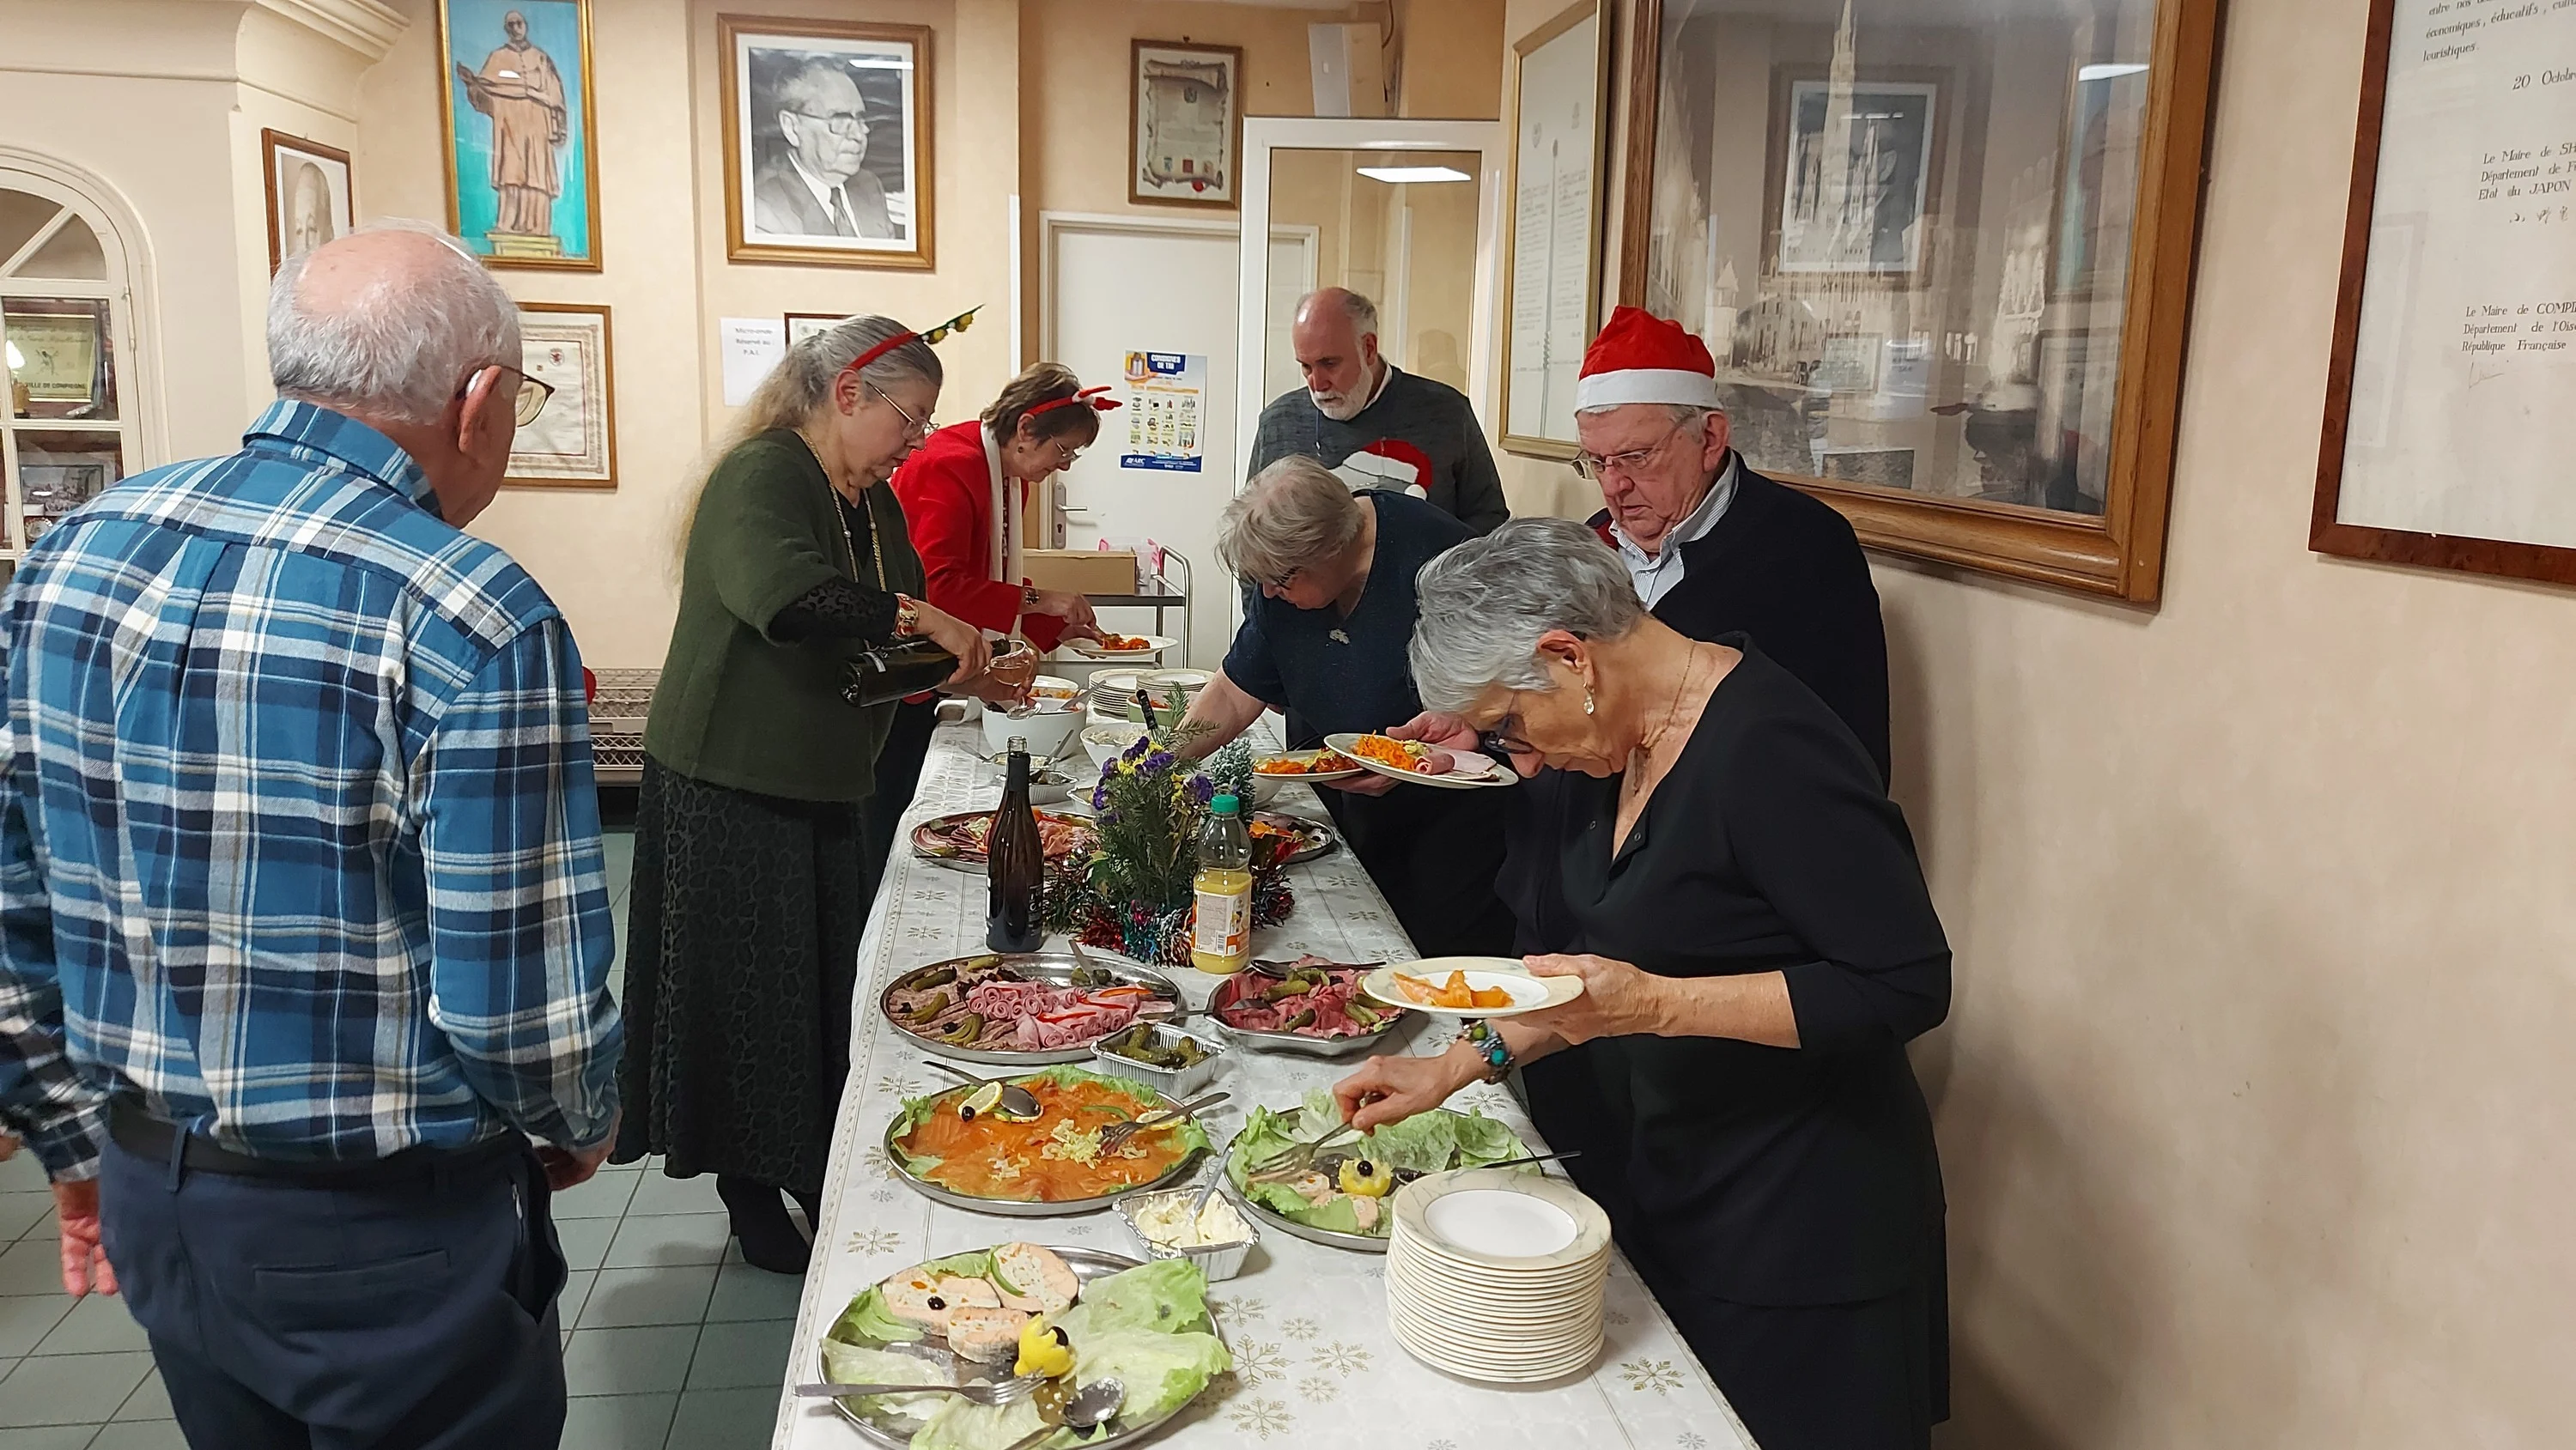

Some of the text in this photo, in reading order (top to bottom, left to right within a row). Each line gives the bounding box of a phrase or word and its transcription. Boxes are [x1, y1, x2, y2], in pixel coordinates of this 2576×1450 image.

[2512, 68, 2576, 90] 20 Octobr
[2483, 153, 2495, 165] Le
[2501, 149, 2531, 162] Maire
[2540, 146, 2552, 158] de
[2481, 166, 2540, 185] Département
[2548, 163, 2561, 175] de
[2478, 179, 2572, 200] Etat du JAPON
[2465, 306, 2476, 317] Le
[2482, 305, 2507, 317] Maire
[2517, 304, 2529, 314] de
[2463, 323, 2518, 339] Département
[2531, 321, 2544, 332] de
[2462, 339, 2567, 355] République Française
